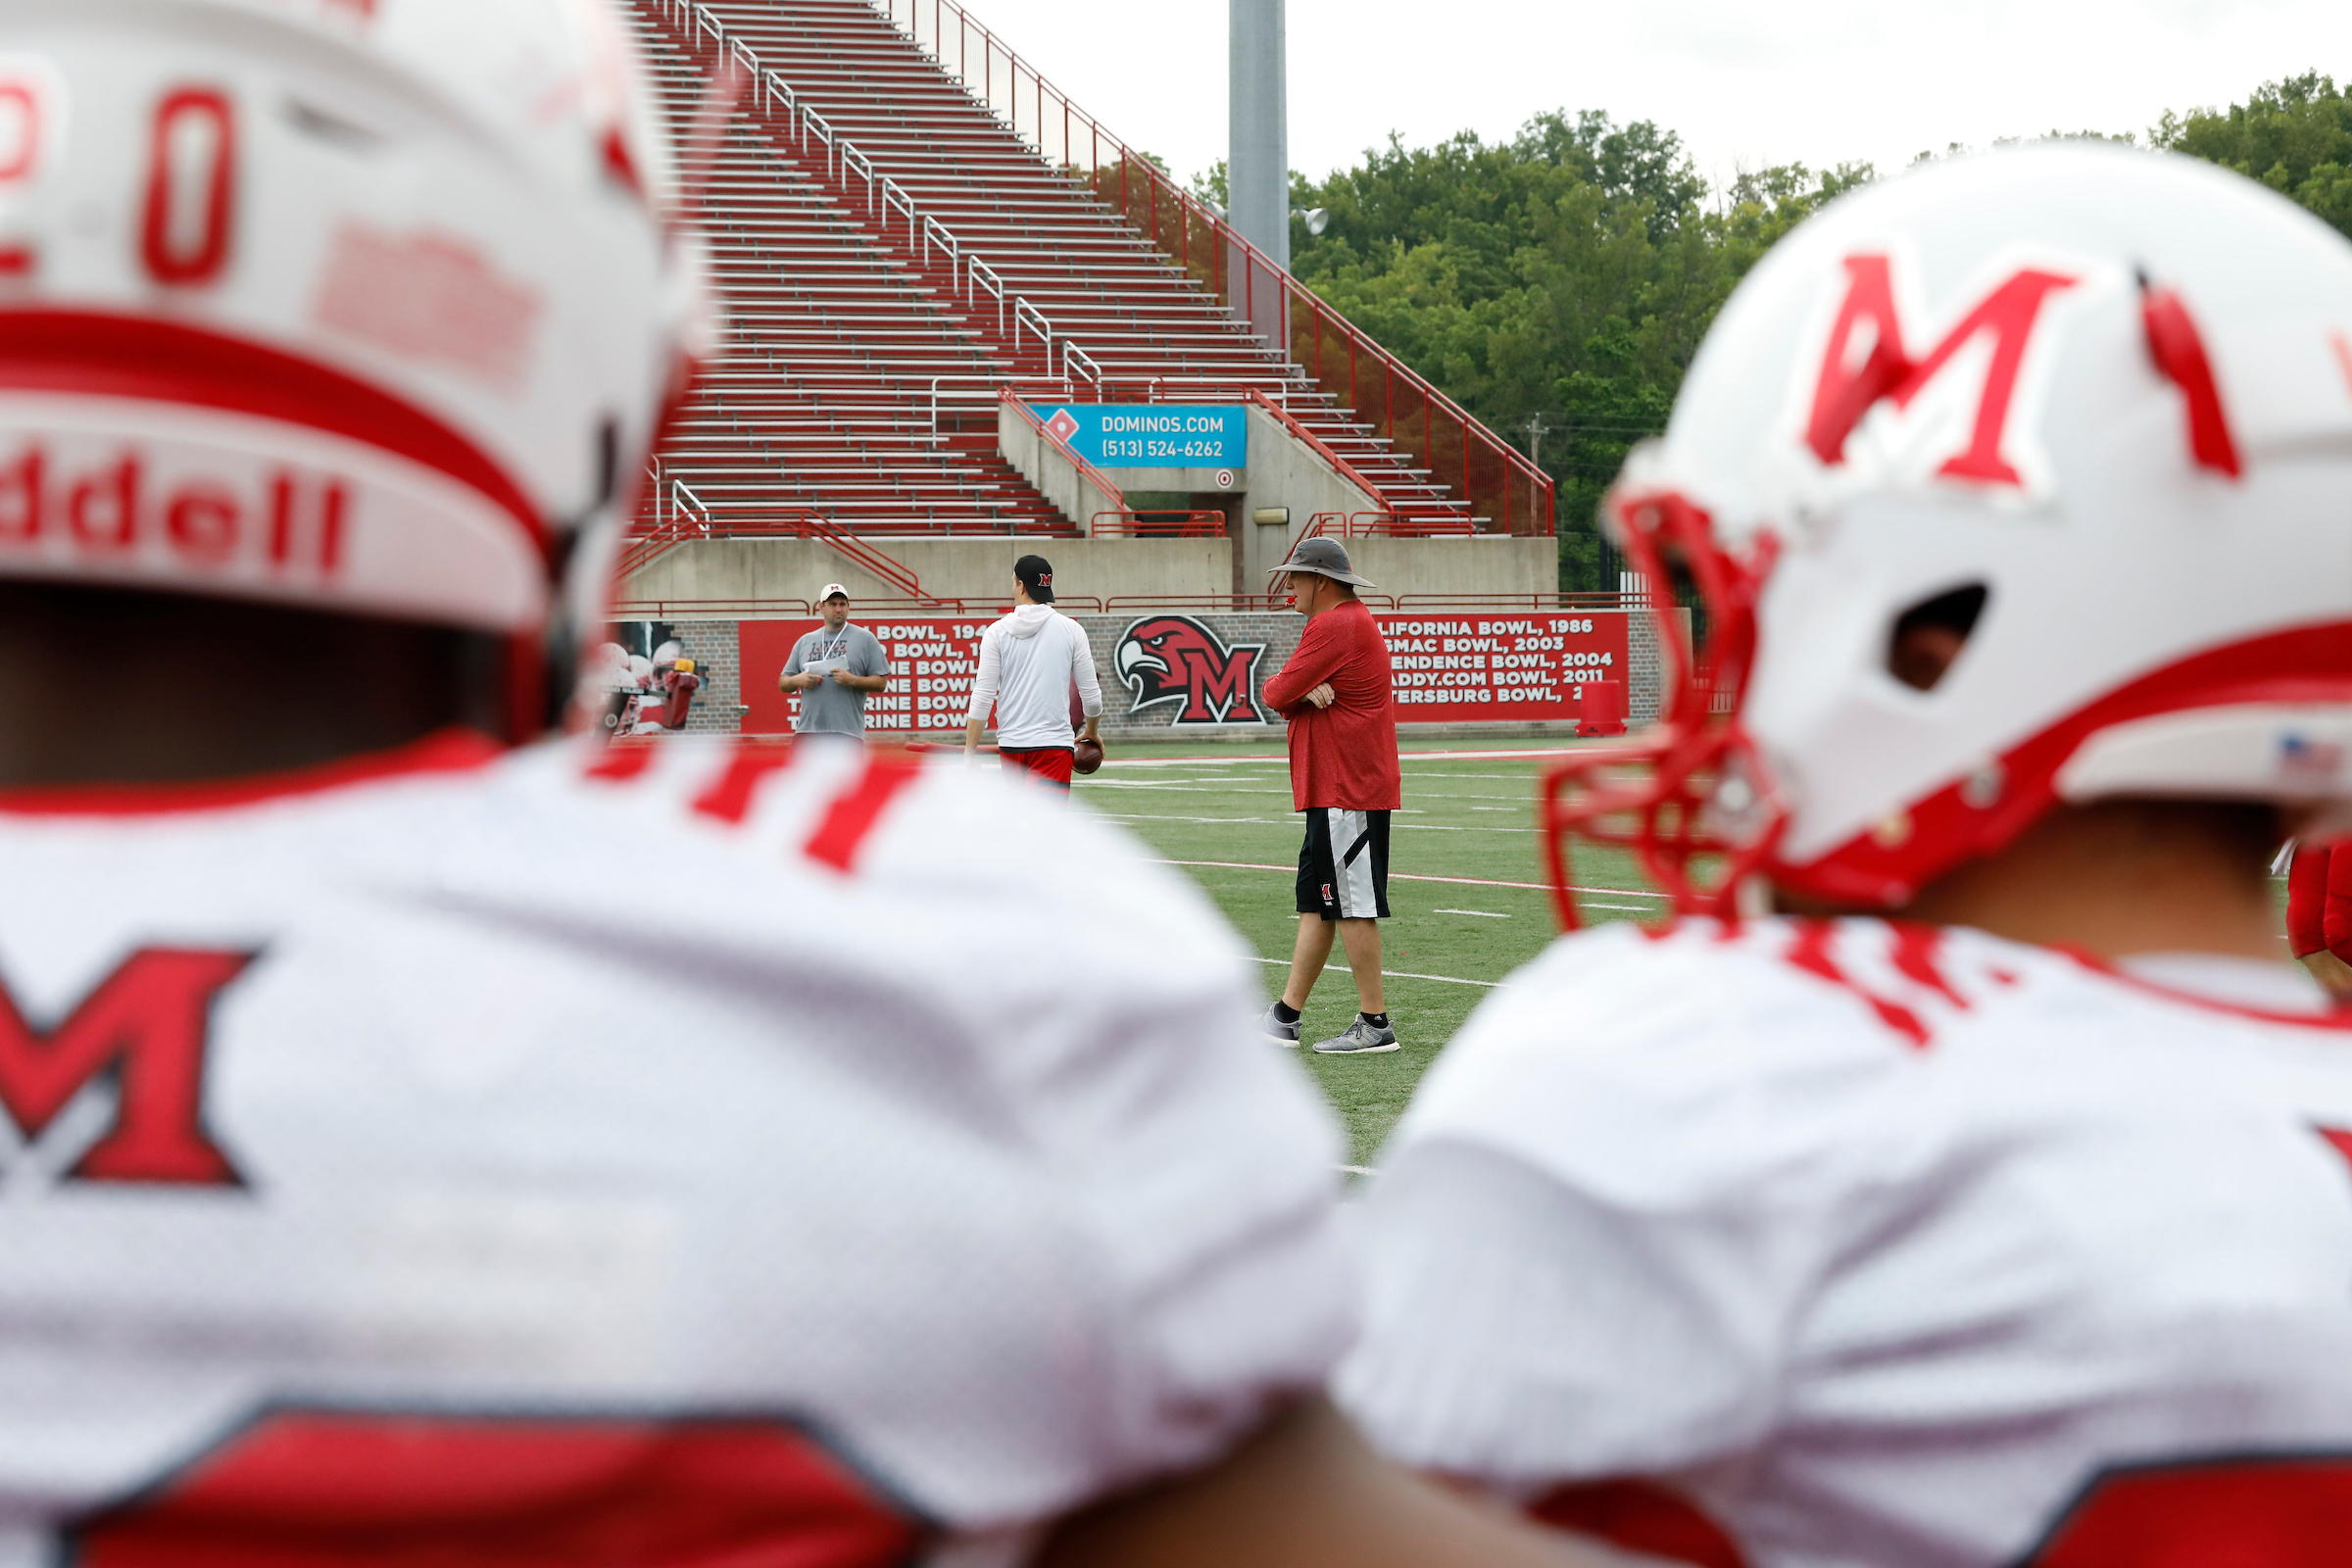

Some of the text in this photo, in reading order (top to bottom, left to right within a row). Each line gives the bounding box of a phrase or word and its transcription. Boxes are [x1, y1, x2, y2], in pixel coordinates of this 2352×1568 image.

[1102, 416, 1224, 433] DOMINOS.COM
[1102, 439, 1223, 458] (513) 524-6262
[0, 443, 351, 576] ddell
[1039, 573, 1052, 586] M
[877, 624, 988, 643] BOWL, 194
[1377, 618, 1593, 637] LIFORNIA BOWL, 1986
[894, 642, 964, 660] BOWL,
[1444, 637, 1509, 655] BOWL,
[1514, 636, 1565, 652] 2003
[916, 660, 978, 676] BOWL
[1391, 652, 1613, 670] ENDENCE BOWL, 2004
[1493, 670, 1558, 686] BOWL,
[1563, 668, 1603, 684] 2011
[917, 695, 970, 711] BOW
[1497, 687, 1562, 704] BOWL,
